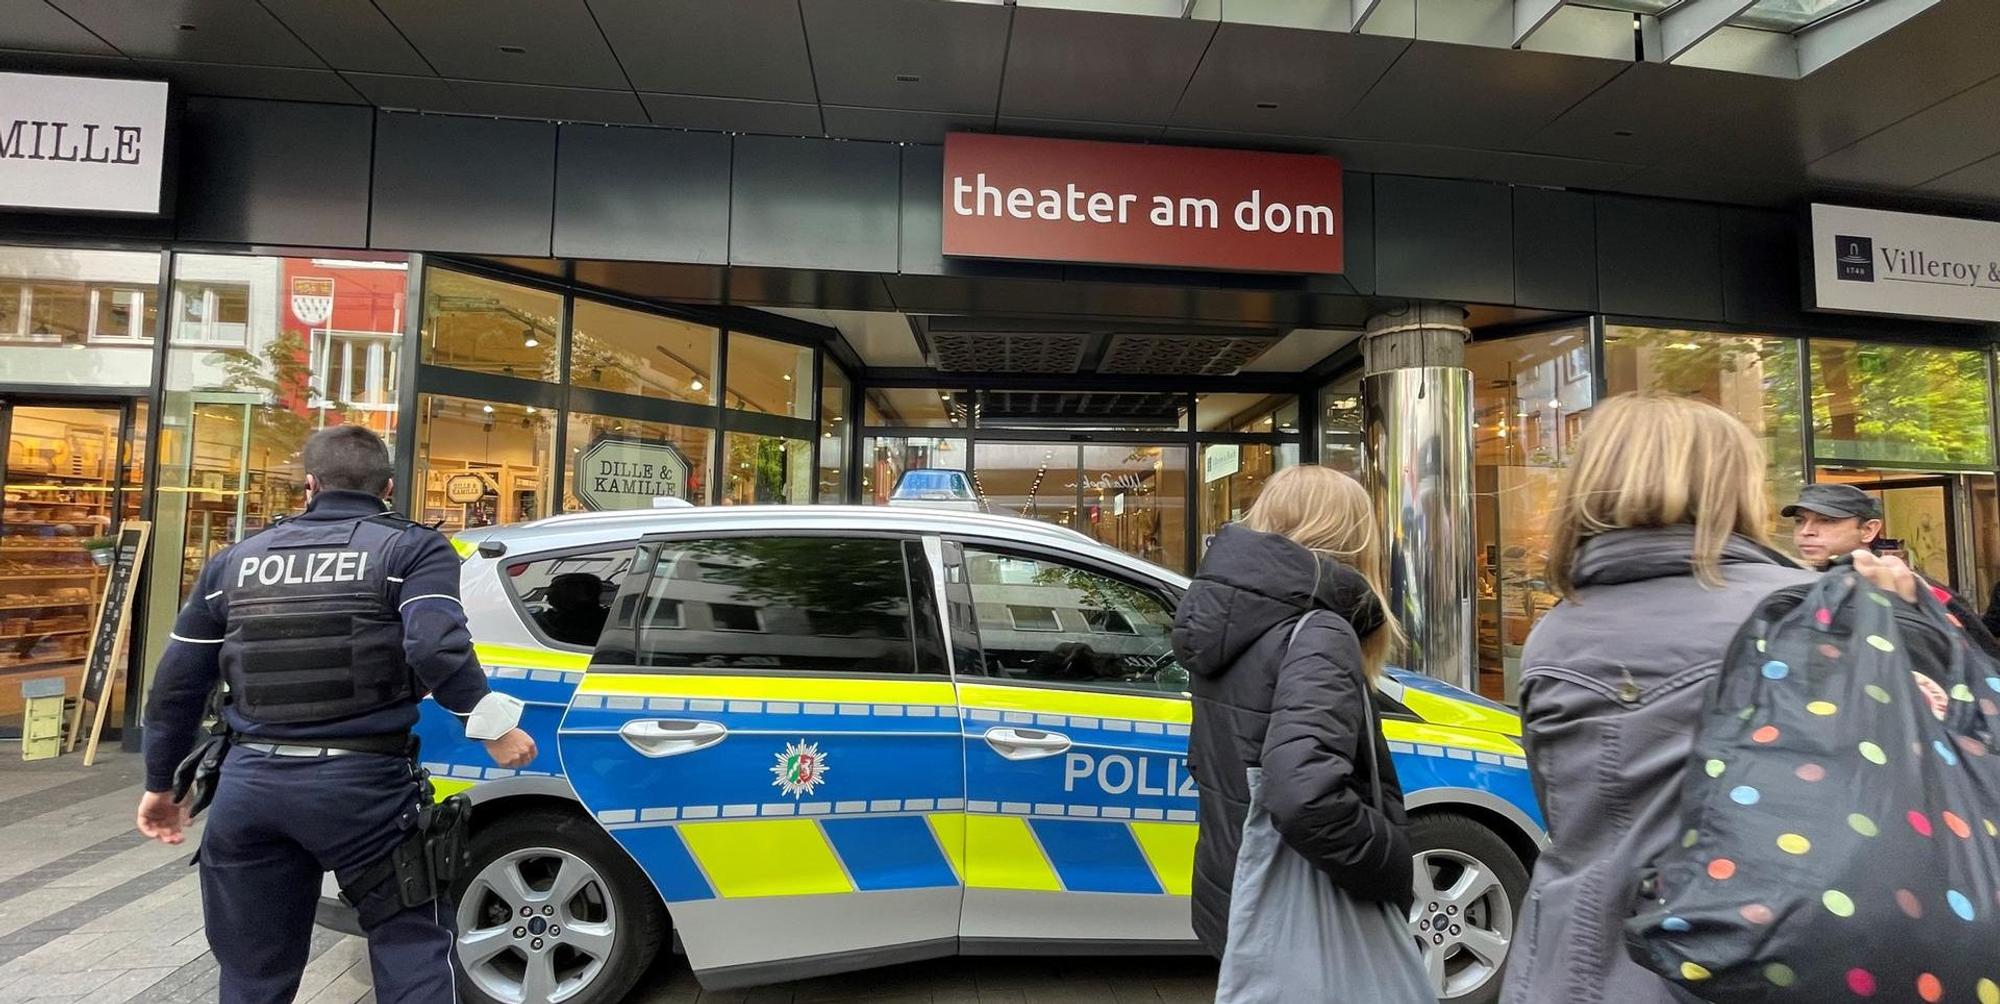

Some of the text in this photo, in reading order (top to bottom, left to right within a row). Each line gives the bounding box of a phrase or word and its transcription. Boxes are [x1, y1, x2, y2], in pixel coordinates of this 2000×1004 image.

[953, 173, 1334, 235] theater am dom
[1881, 247, 1981, 286] Villeroy
[594, 477, 675, 496] KAMILLE
[600, 460, 672, 480] DILLE &
[237, 551, 368, 588] POLIZEI
